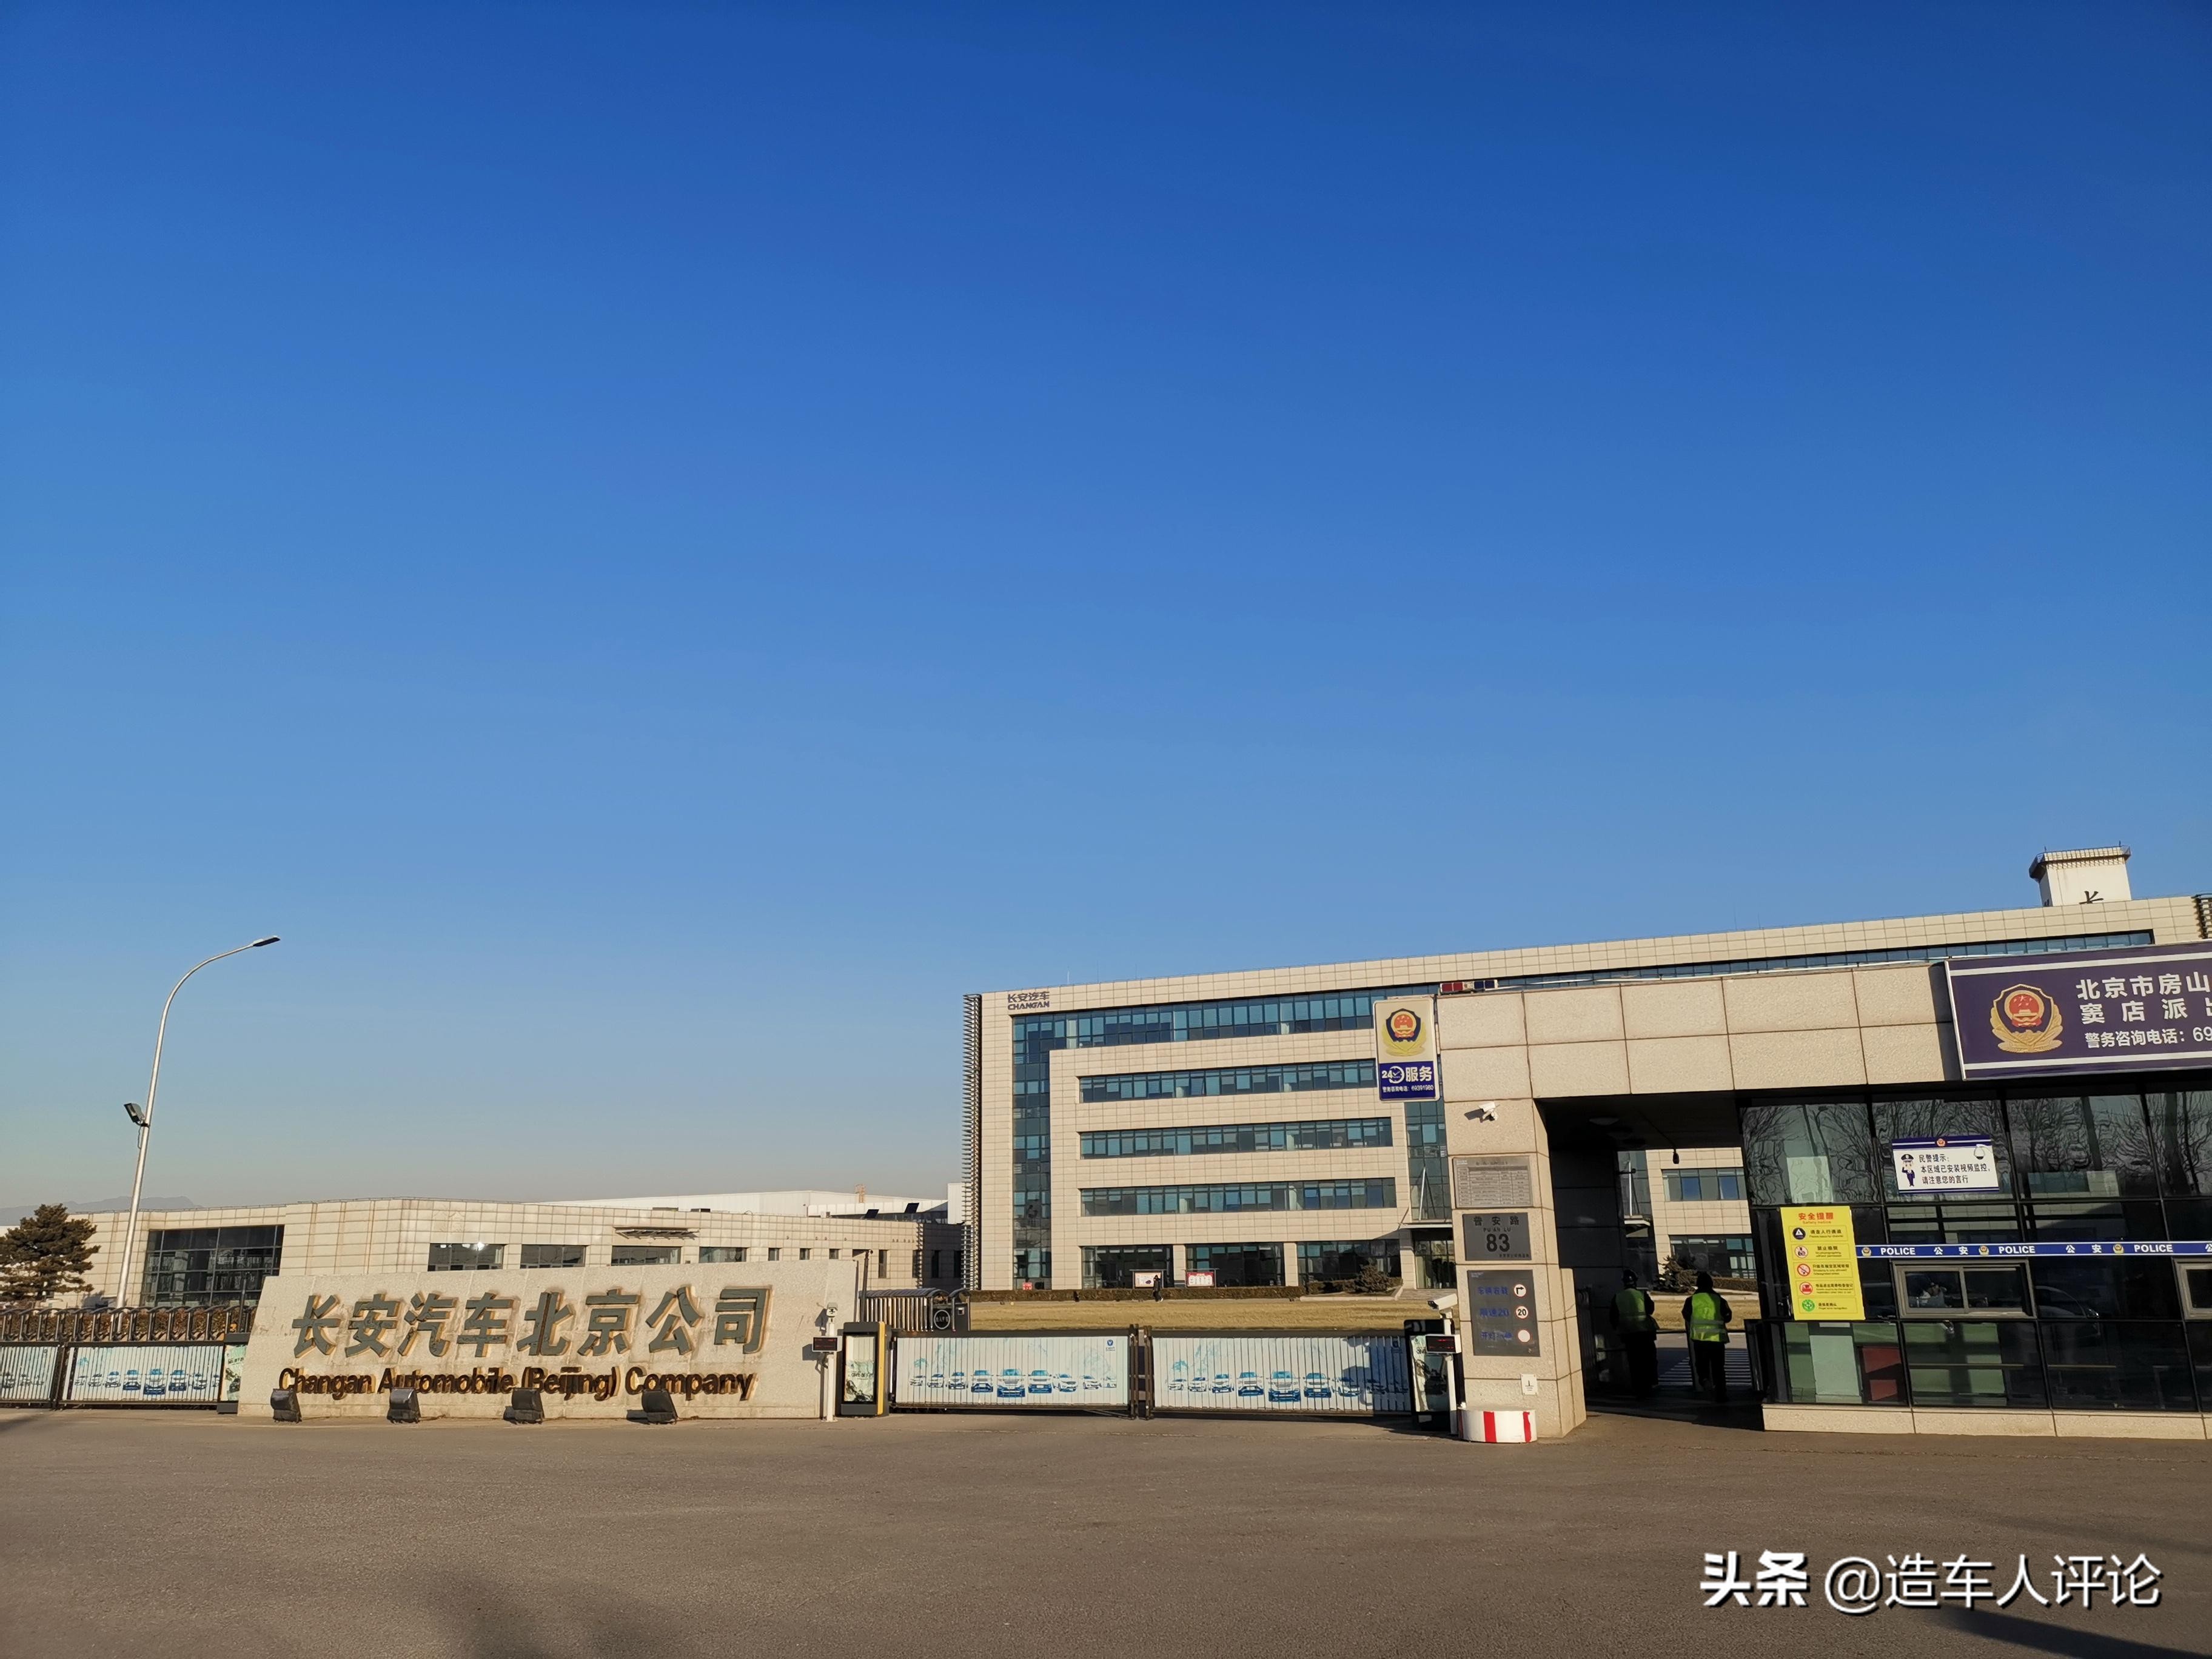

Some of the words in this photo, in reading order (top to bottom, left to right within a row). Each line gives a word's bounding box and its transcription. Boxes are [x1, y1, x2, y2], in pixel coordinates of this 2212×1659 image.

[2076, 971, 2210, 1000] 北京市房山
[1007, 991, 1050, 1003] 长安汽车
[1007, 1001, 1050, 1010] CHANGAN
[1406, 1066, 1432, 1082] 服务
[1919, 1154, 1950, 1162] 民警提示：
[1922, 1175, 1968, 1184] 请注意您的言行
[1473, 1216, 1519, 1225] 普安路
[1486, 1233, 1510, 1252] 83
[1999, 1245, 2036, 1254] POLICE
[292, 1285, 771, 1358] 长安汽车北京公司
[279, 1368, 374, 1400] Changan
[377, 1367, 514, 1394] Automobile
[521, 1366, 618, 1401] (Beijing)
[625, 1366, 756, 1401] Company
